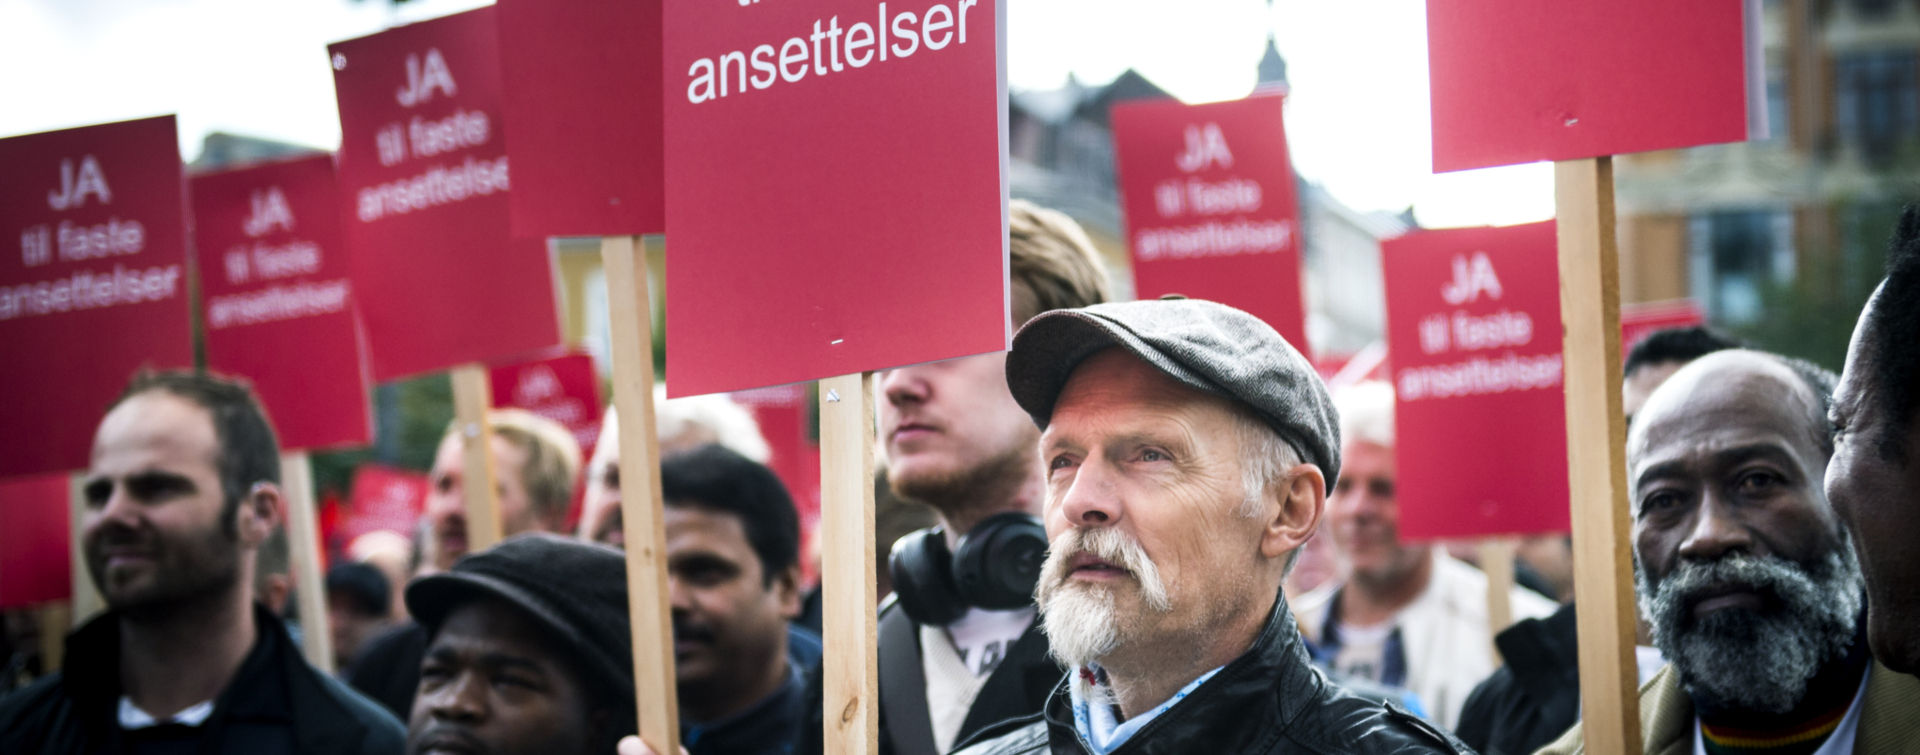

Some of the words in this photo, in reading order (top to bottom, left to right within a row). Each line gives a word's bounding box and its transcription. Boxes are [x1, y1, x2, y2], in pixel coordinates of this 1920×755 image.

[687, 0, 978, 104] ansettelser
[397, 49, 456, 107] JA
[376, 122, 407, 166] til
[409, 109, 490, 157] faste
[1175, 122, 1234, 173] JA
[48, 155, 111, 211] JA
[357, 155, 509, 222] ansettelse
[1186, 176, 1262, 216] faste
[243, 186, 295, 237] JA
[21, 224, 51, 267] til
[57, 217, 145, 261] faste
[252, 240, 323, 280] faste
[1134, 217, 1292, 262] ansettelser
[209, 277, 350, 329] ansettelser
[1441, 251, 1503, 305] JA
[1419, 313, 1449, 355] til
[1451, 310, 1533, 350] faste
[1398, 352, 1563, 401] ansettelser
